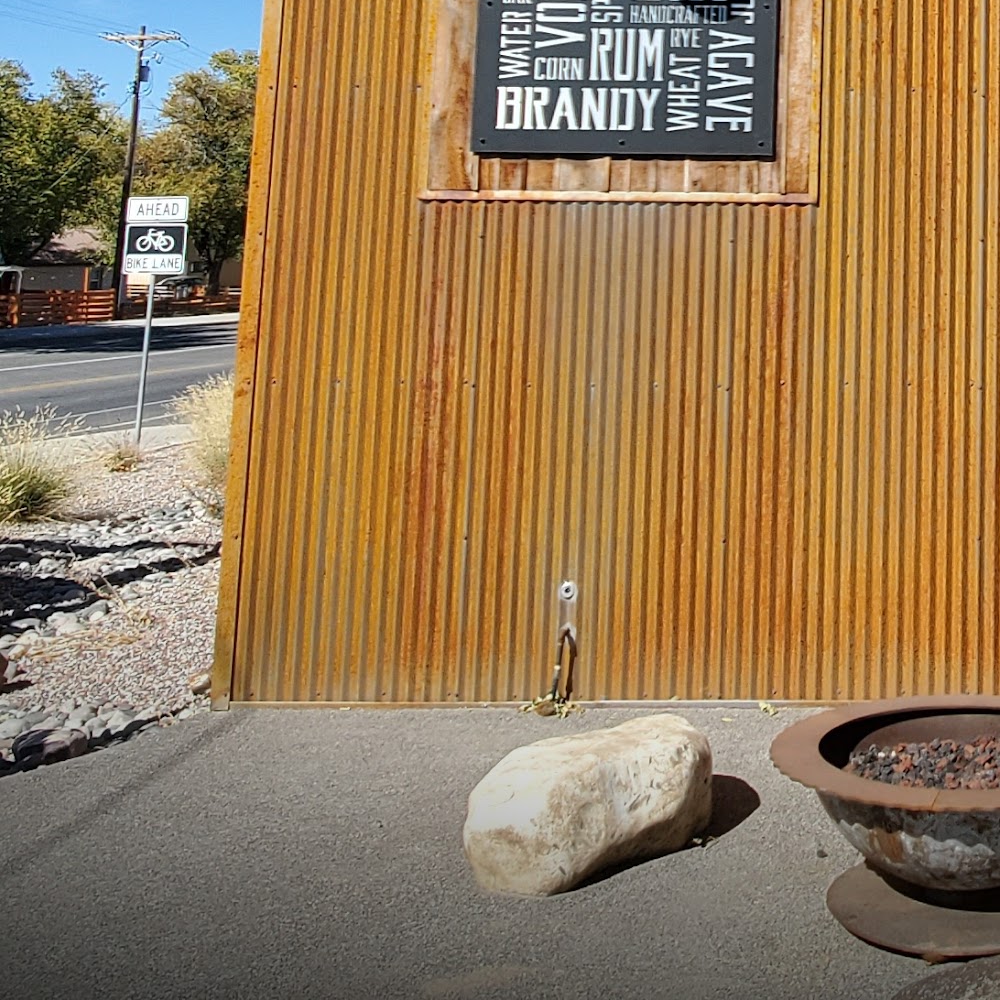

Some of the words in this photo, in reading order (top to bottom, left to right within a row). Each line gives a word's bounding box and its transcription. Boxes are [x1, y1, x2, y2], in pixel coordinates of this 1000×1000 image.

[629, 4, 728, 24] HANDCRAFTED
[498, 11, 533, 79] WATER
[588, 28, 665, 82] RUM
[669, 28, 704, 48] RYE
[533, 56, 585, 81] CORN
[705, 29, 756, 132] AGAVE
[495, 86, 662, 131] BRANDY
[665, 53, 703, 132] WHEAT
[136, 202, 180, 216] AHEAD
[126, 257, 149, 269] BIKE
[152, 257, 181, 269] LANE
